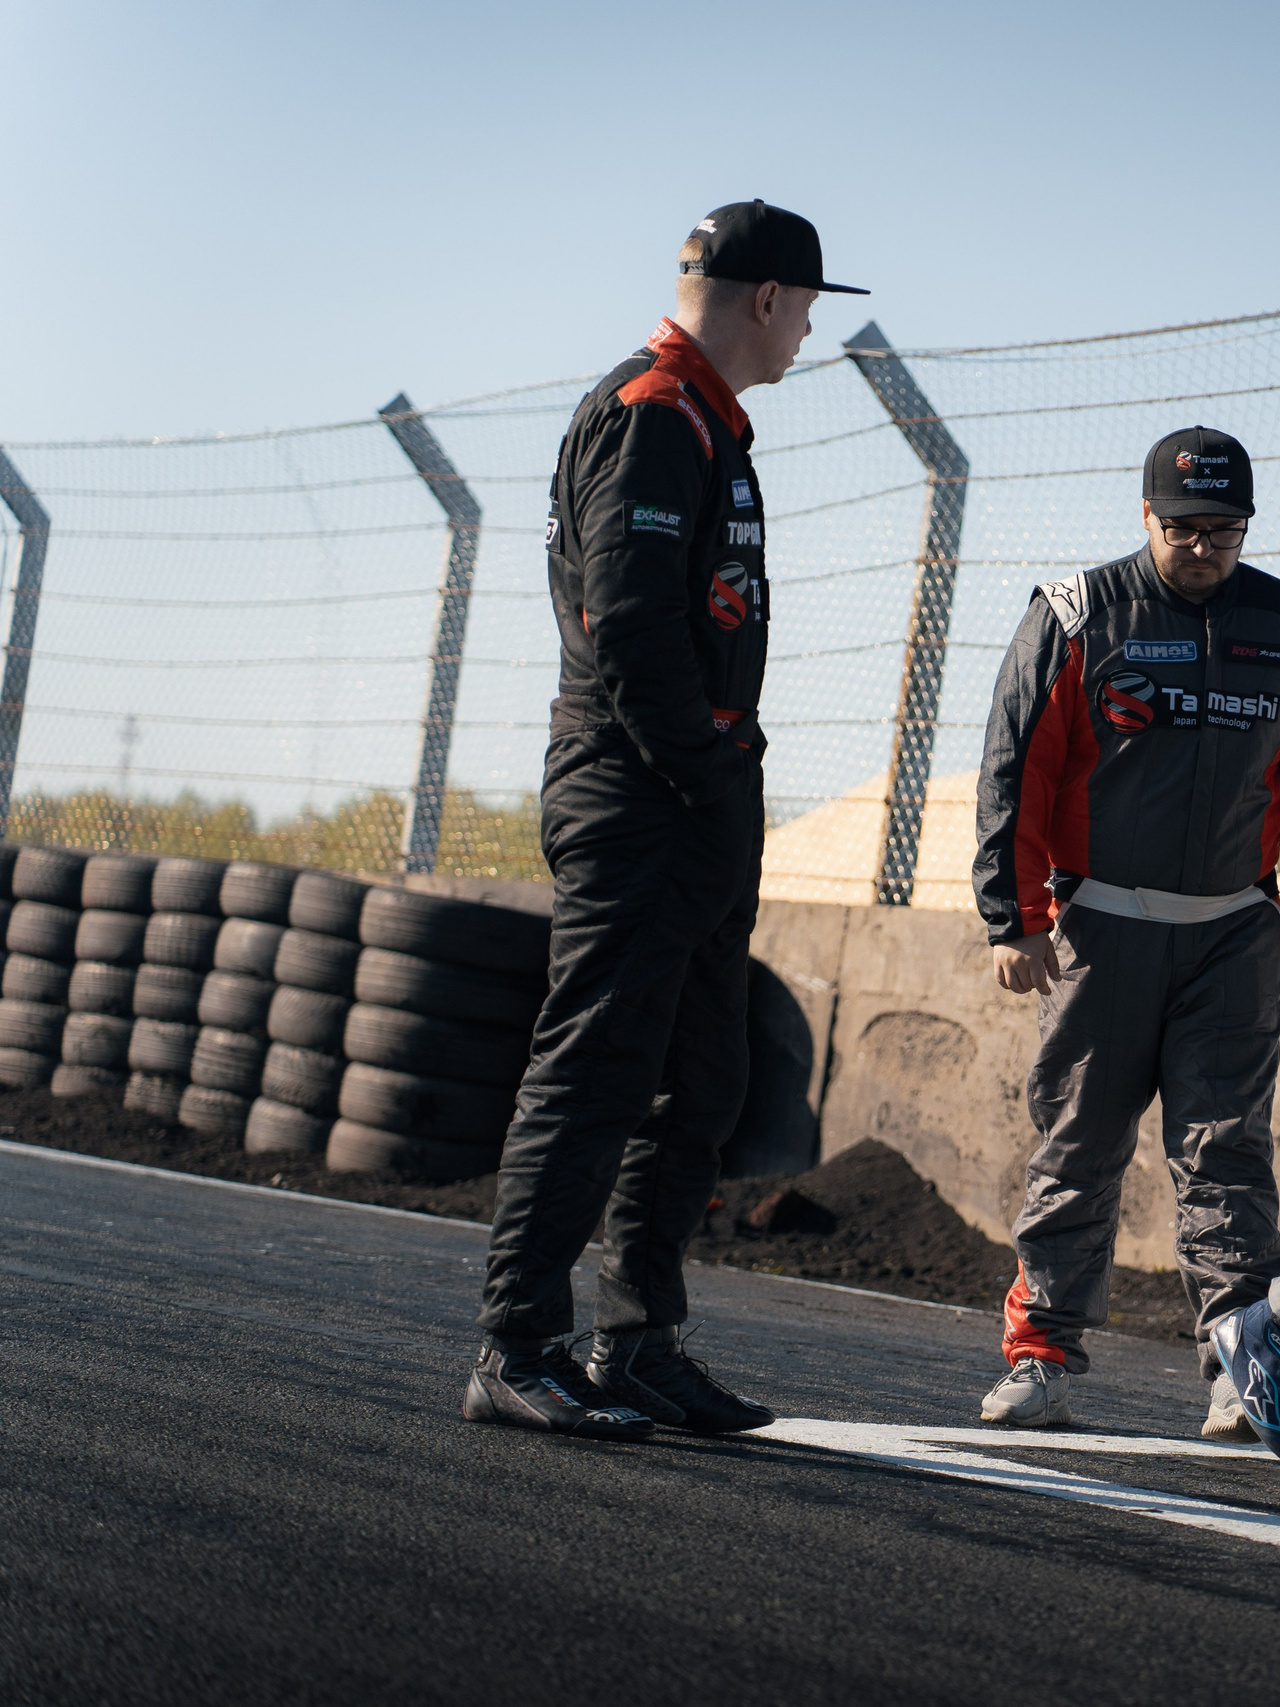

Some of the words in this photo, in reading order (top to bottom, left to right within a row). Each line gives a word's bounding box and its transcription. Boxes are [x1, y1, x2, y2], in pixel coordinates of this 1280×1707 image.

[1193, 455, 1229, 464] Tamashi
[633, 509, 681, 526] EXHAUST
[1207, 714, 1252, 730] technology
